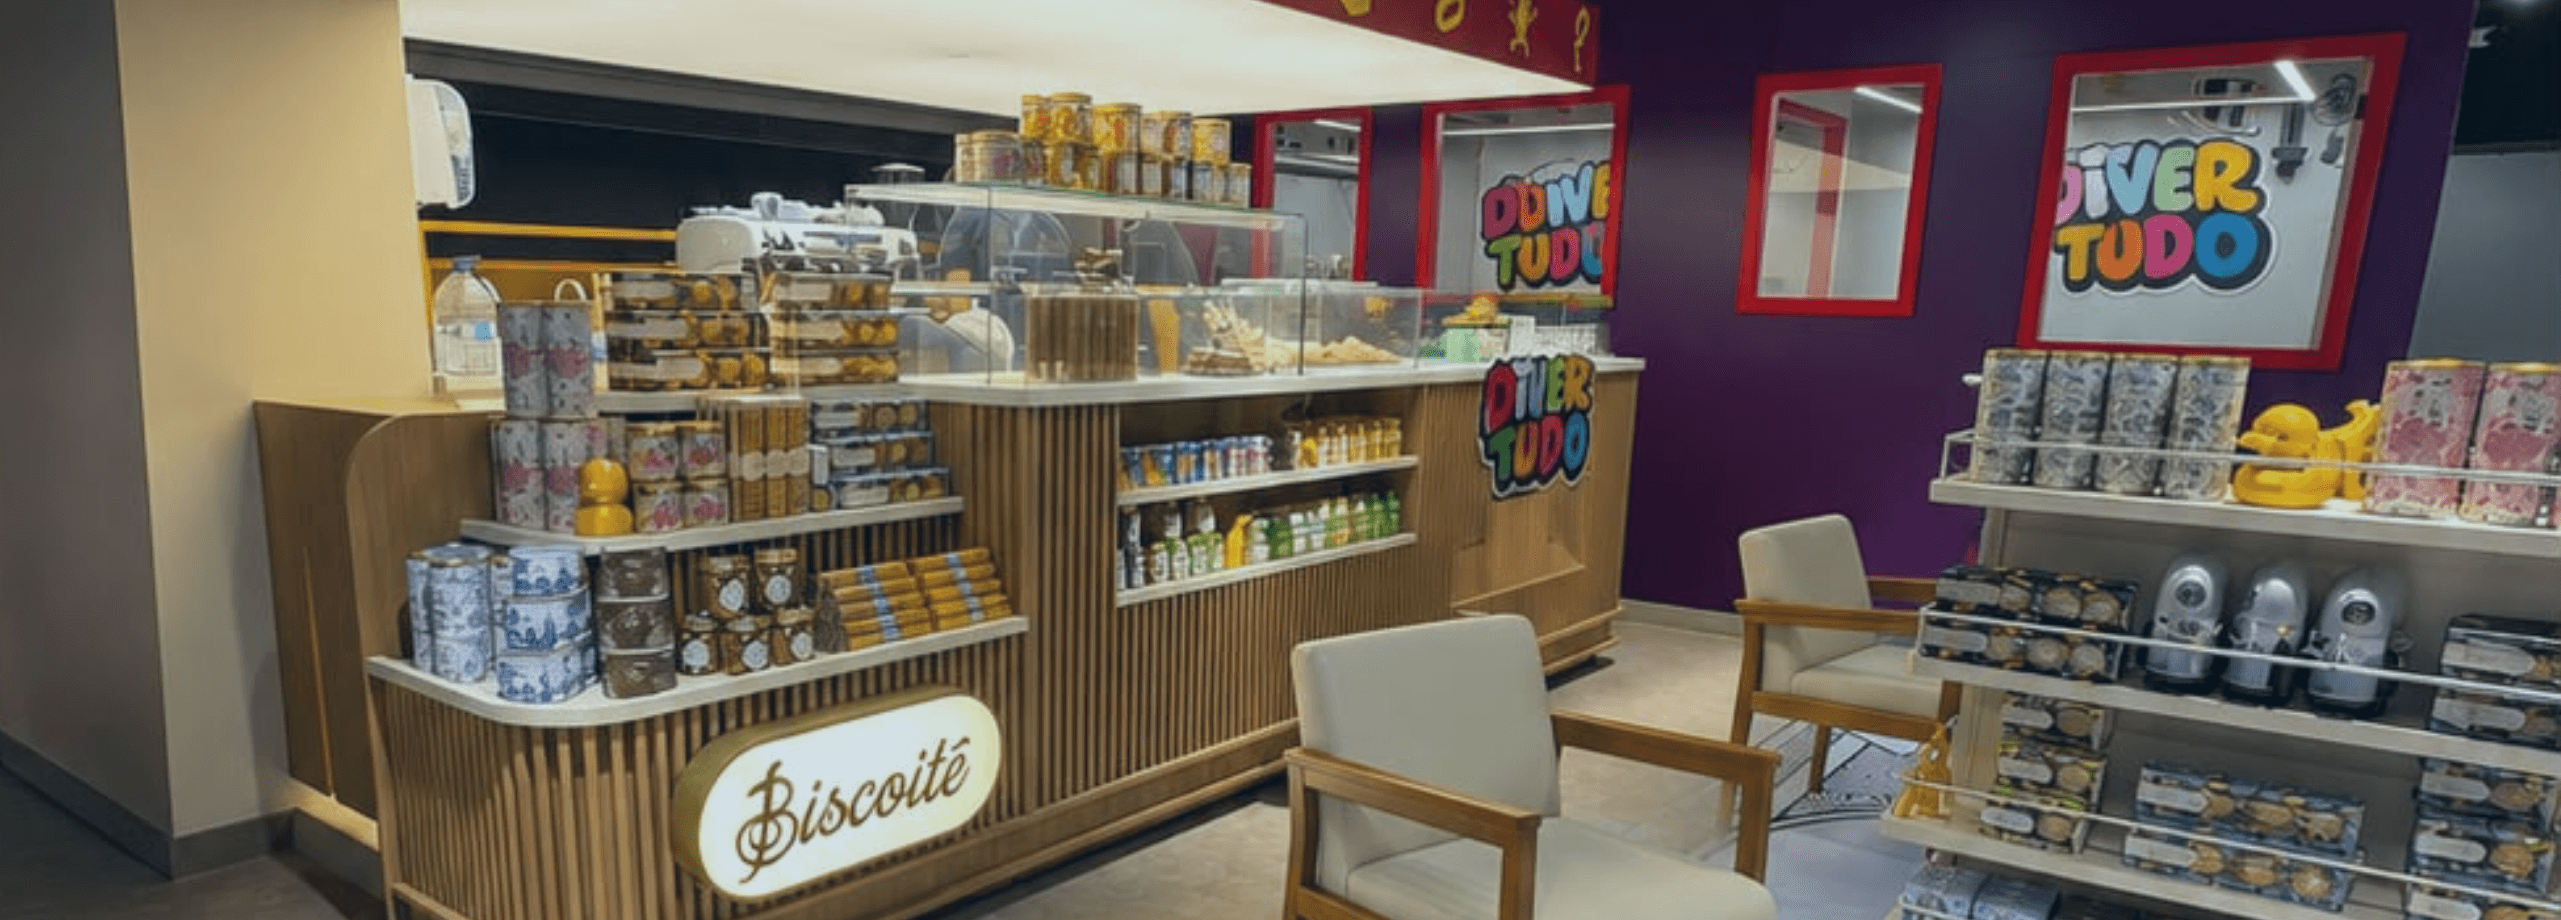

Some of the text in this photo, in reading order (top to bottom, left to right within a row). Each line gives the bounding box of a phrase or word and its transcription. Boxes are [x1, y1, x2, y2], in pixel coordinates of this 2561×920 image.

[2055, 211, 2261, 282] TUDO
[1483, 355, 1592, 435] DIVER
[1489, 411, 1588, 481] TUDO
[735, 735, 972, 885] Biscoitê
